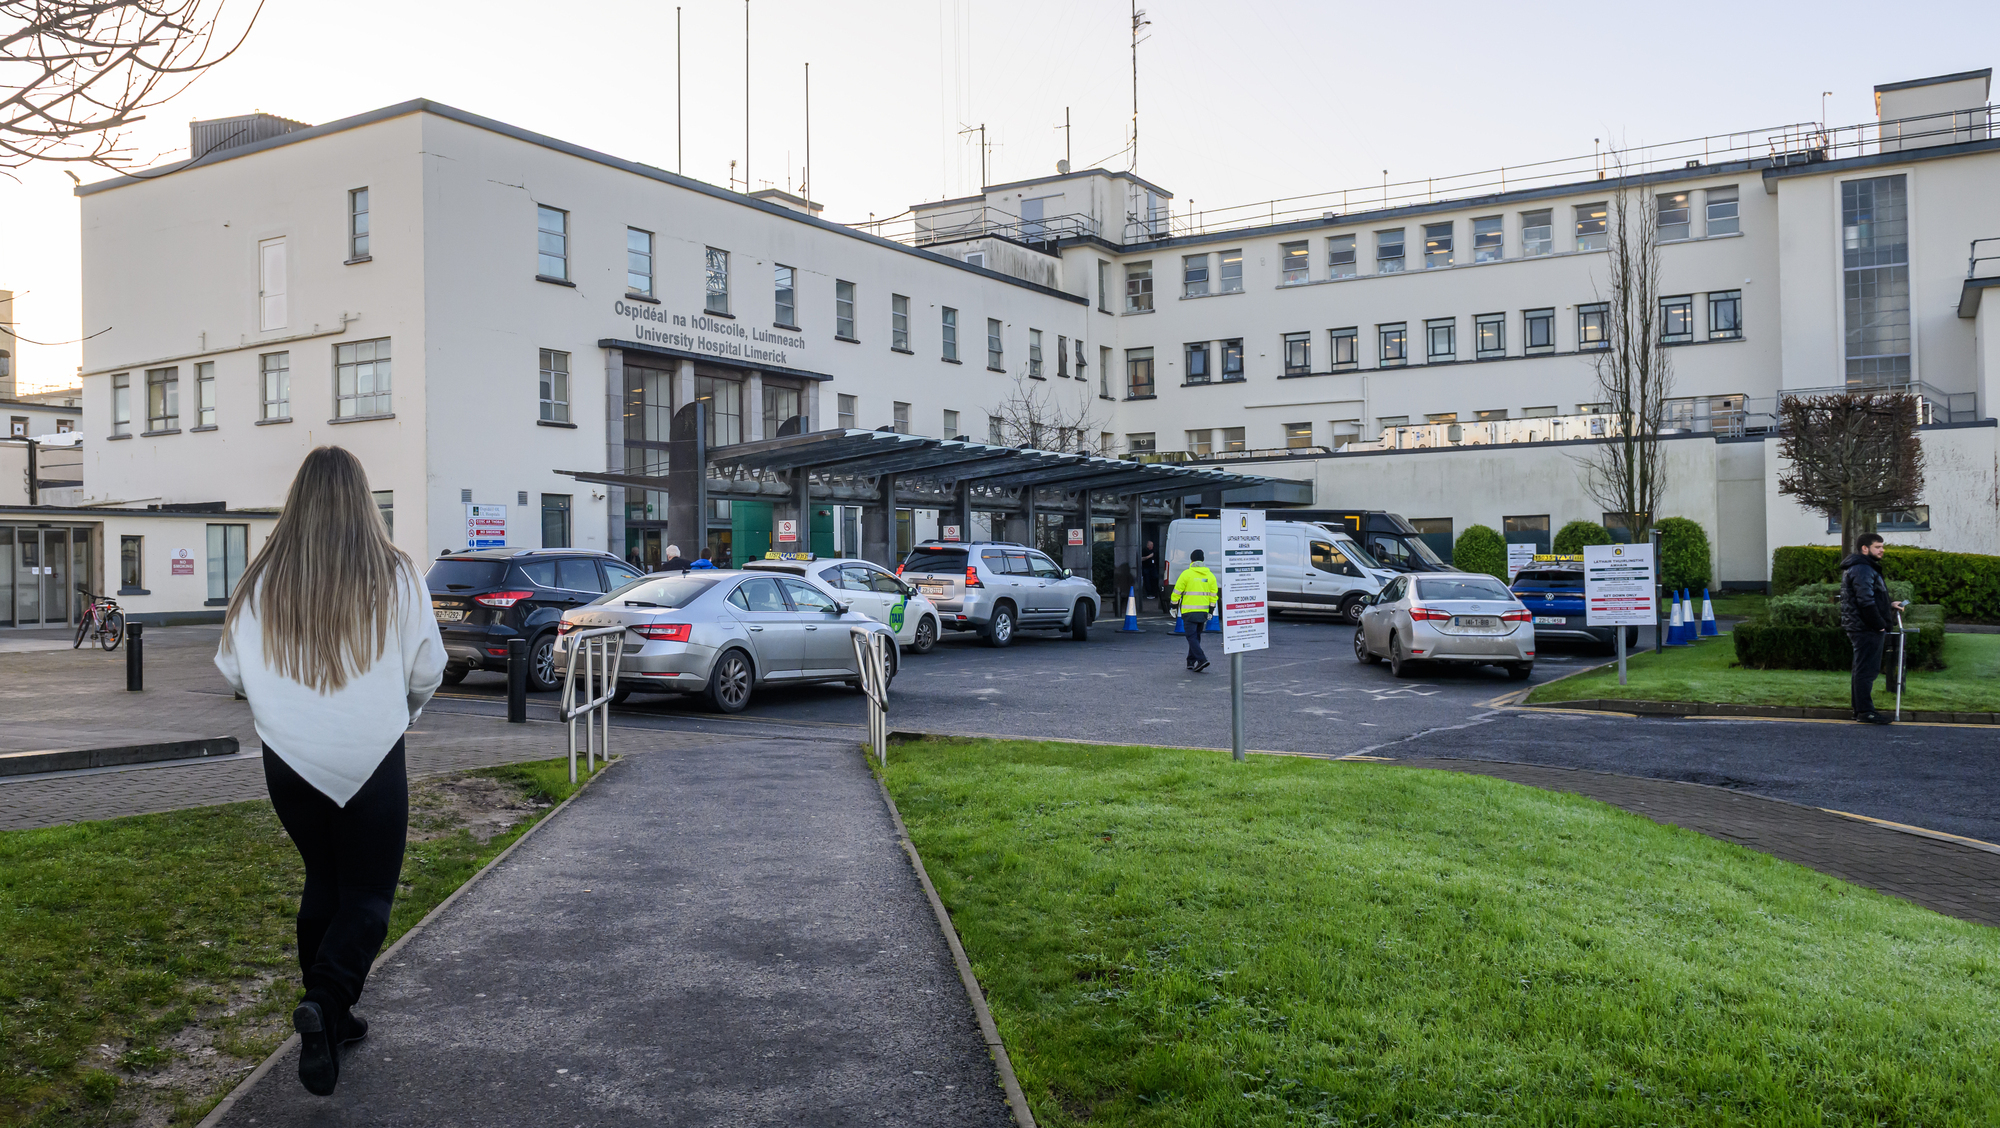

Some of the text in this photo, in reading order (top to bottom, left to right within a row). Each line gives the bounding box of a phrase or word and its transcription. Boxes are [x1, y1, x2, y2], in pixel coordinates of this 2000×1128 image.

[614, 300, 805, 350] Ospidéal na hOllscoile, Luimneach
[635, 324, 787, 364] University Hospital Limerick
[892, 613, 902, 623] TAXI
